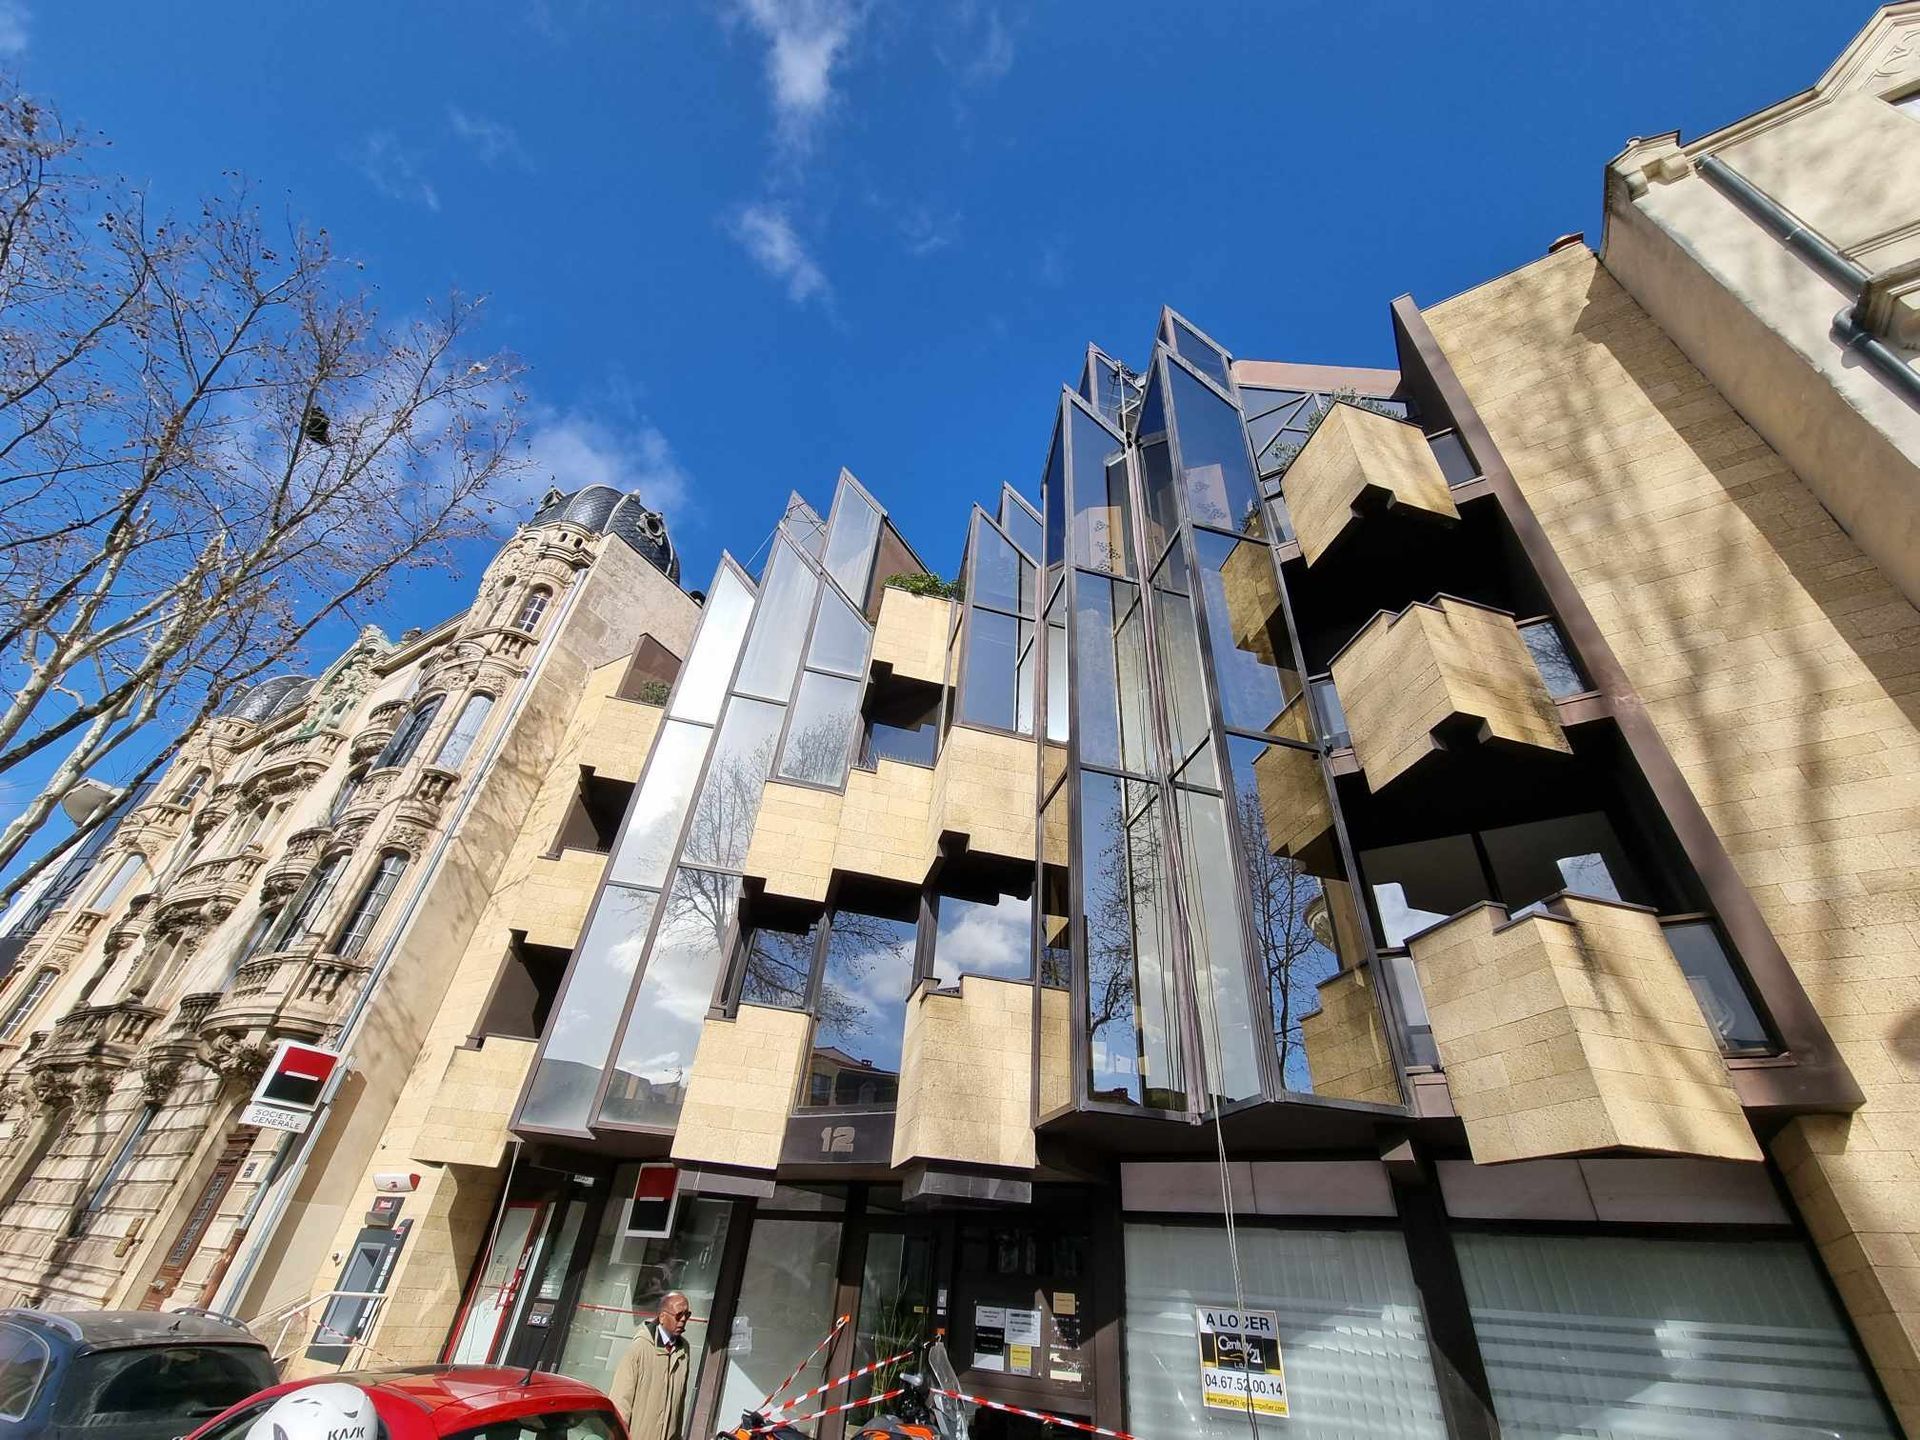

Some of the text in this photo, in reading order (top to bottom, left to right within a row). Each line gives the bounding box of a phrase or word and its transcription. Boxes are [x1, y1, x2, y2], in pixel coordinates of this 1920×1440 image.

[255, 1109, 296, 1122] SOCIETE
[252, 1116, 301, 1130] GENERALE
[821, 1126, 855, 1152] 12
[1206, 1313, 1216, 1327] A
[1217, 1335, 1253, 1354] Centuy
[1205, 1373, 1283, 1396] 04.67.52.00.14
[327, 1426, 366, 1440] KASK
